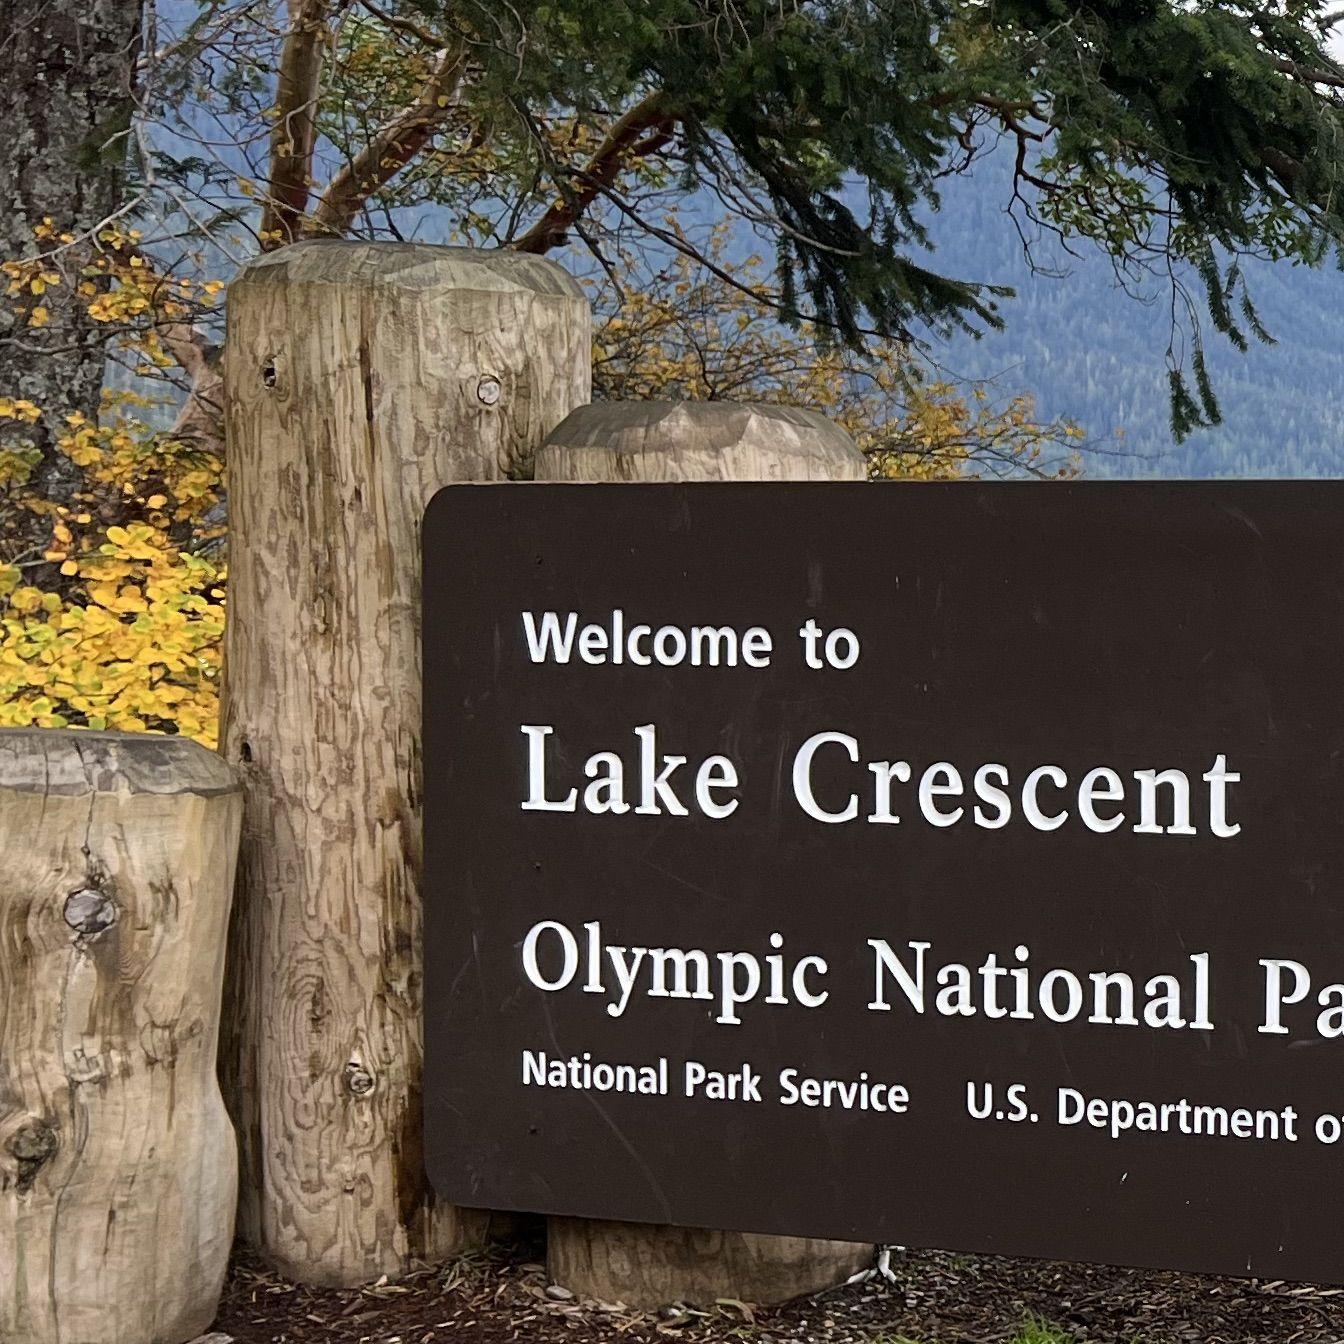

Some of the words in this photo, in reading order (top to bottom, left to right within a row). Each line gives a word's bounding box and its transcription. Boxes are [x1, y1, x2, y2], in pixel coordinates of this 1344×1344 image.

[520, 609, 773, 668] Welcome
[799, 618, 860, 670] to
[520, 723, 739, 820] Lake
[792, 731, 1242, 839] Crescent
[522, 920, 829, 1025] Olympic
[867, 938, 1215, 1031] National
[522, 1050, 668, 1095] National
[685, 1061, 762, 1102] Park
[779, 1068, 910, 1113] Service
[967, 1081, 1039, 1123] U.S.
[1058, 1087, 1298, 1142] Department
